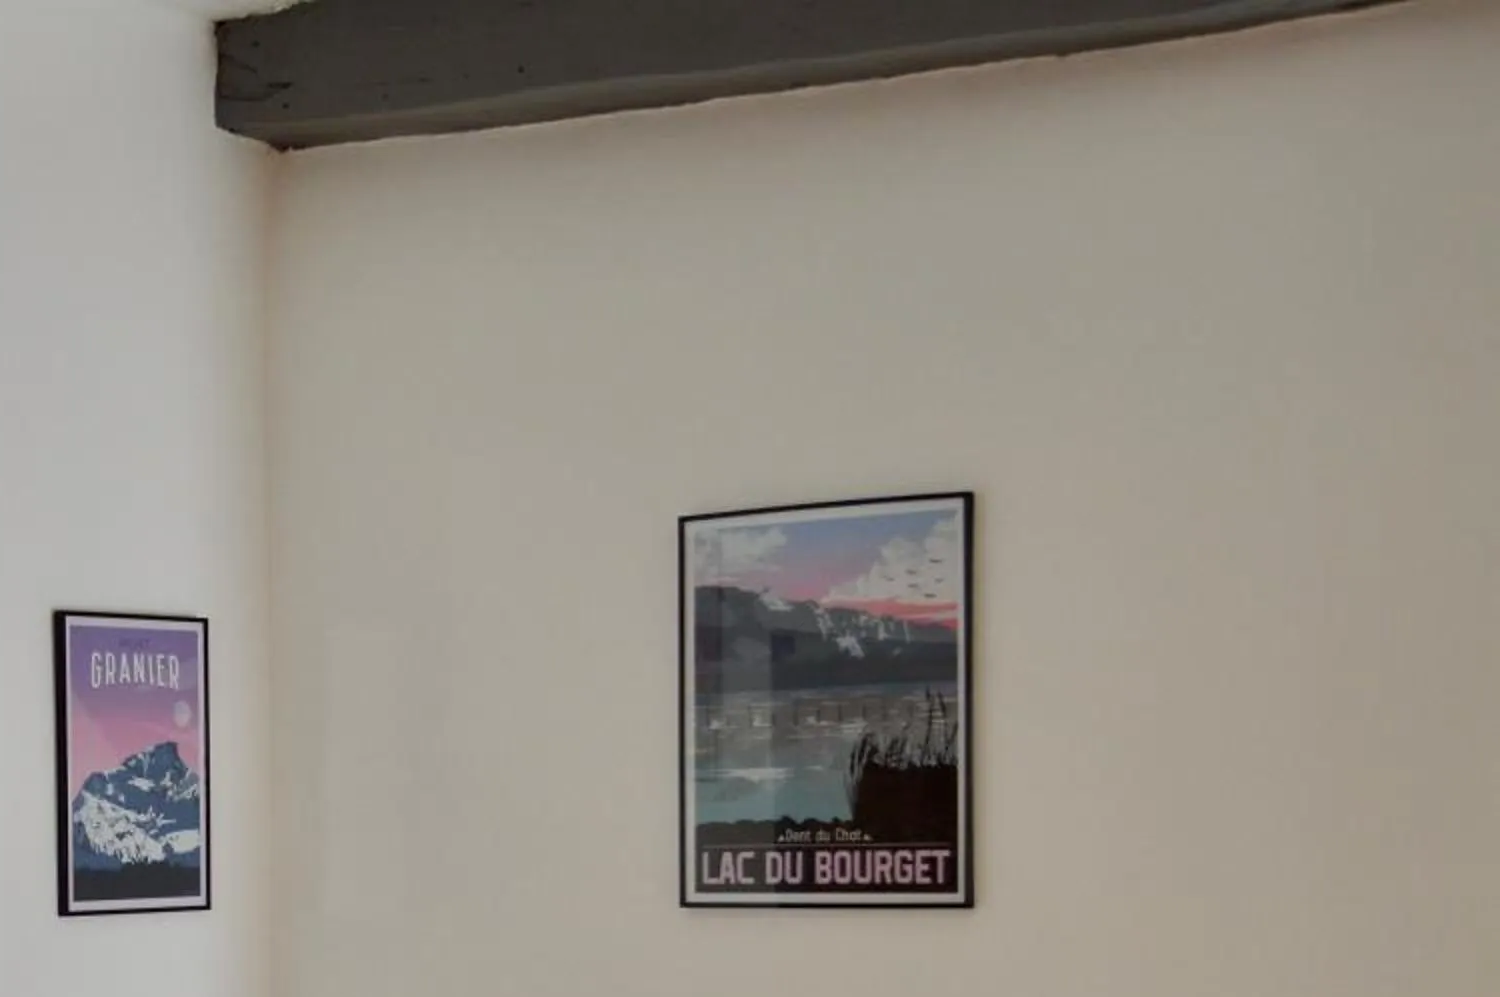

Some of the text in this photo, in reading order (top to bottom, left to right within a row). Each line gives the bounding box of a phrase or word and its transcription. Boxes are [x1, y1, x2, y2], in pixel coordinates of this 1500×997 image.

[90, 651, 181, 690] GRANIER
[785, 828, 811, 842] Dent
[815, 829, 831, 841] du
[702, 849, 951, 886] LAC DU BOURGET
